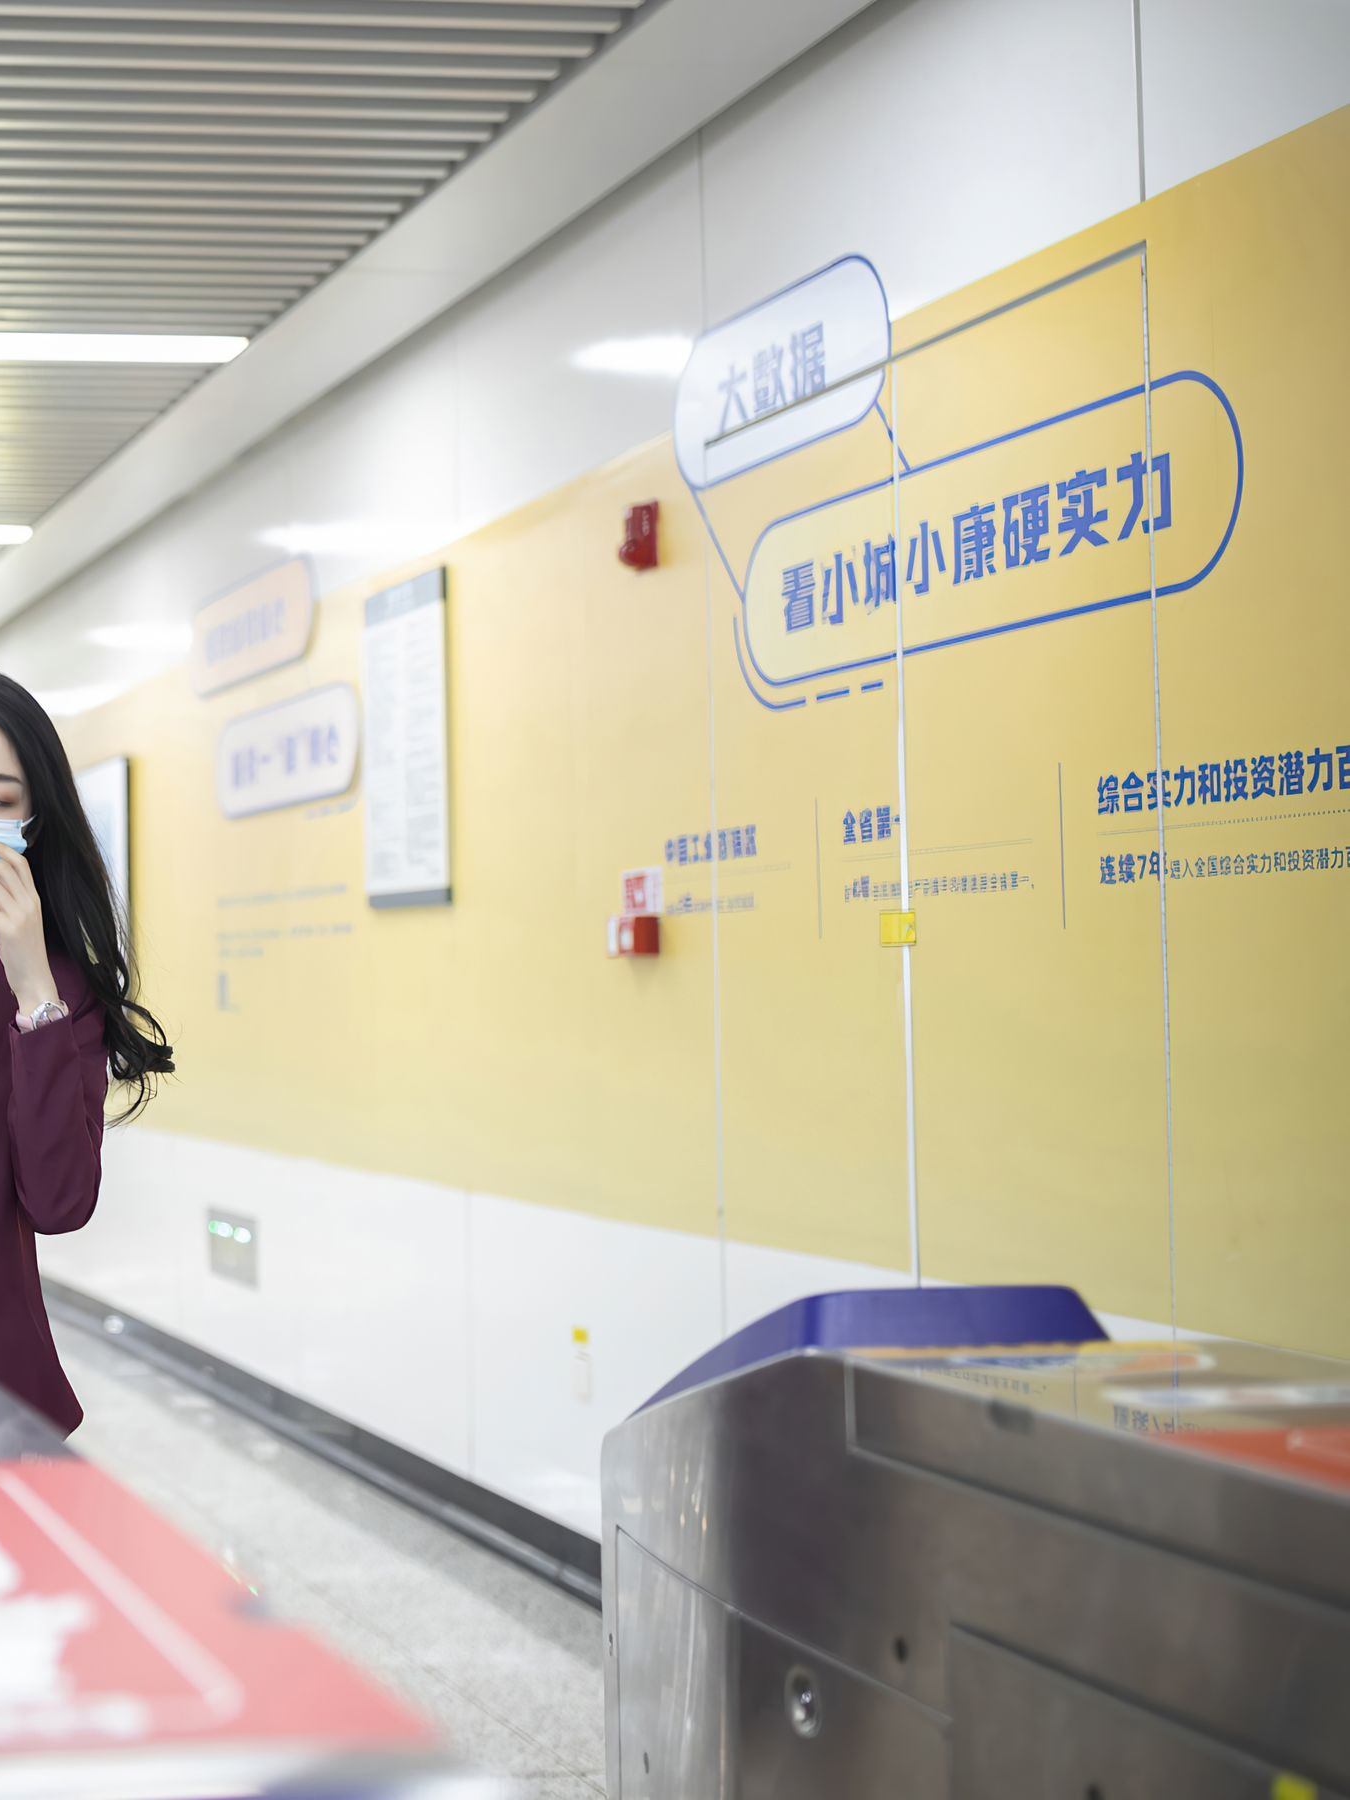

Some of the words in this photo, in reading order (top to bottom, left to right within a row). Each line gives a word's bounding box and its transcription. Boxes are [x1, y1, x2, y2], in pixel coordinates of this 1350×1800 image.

[717, 321, 826, 434] 大数据
[781, 451, 1172, 633] 看小城小康硬实力
